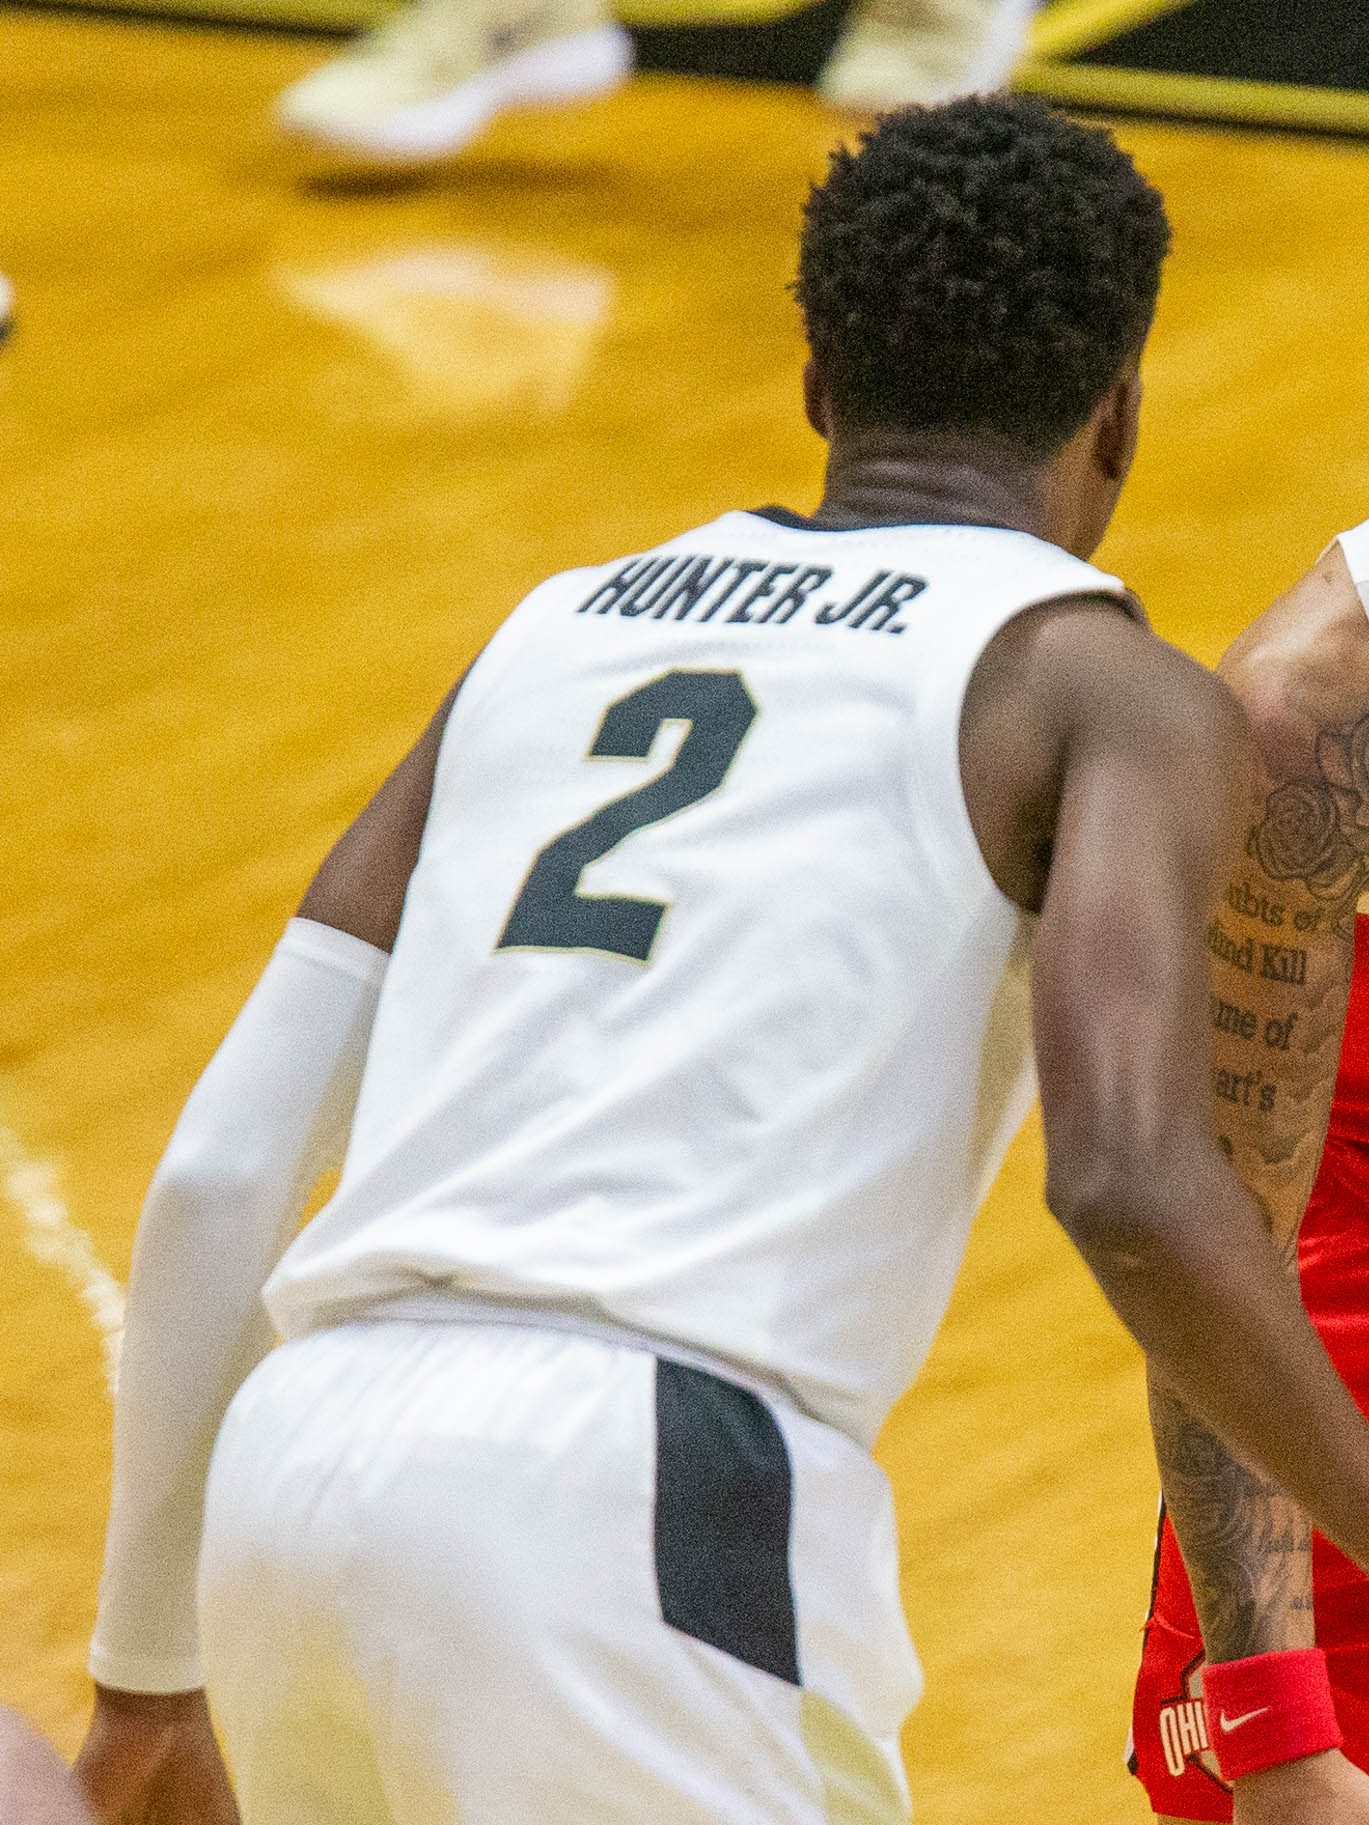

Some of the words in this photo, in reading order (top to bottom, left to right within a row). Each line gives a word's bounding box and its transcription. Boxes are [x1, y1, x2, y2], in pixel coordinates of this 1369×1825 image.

[576, 553, 832, 625] HUNTER
[814, 569, 928, 634] JR.
[494, 667, 761, 967] 2
[1227, 881, 1284, 928] ubts
[1260, 944, 1307, 985] Kill
[1209, 998, 1257, 1040] me
[1264, 1012, 1299, 1051] of
[1216, 1070, 1277, 1112] art's
[1159, 1701, 1209, 1777] OHI
